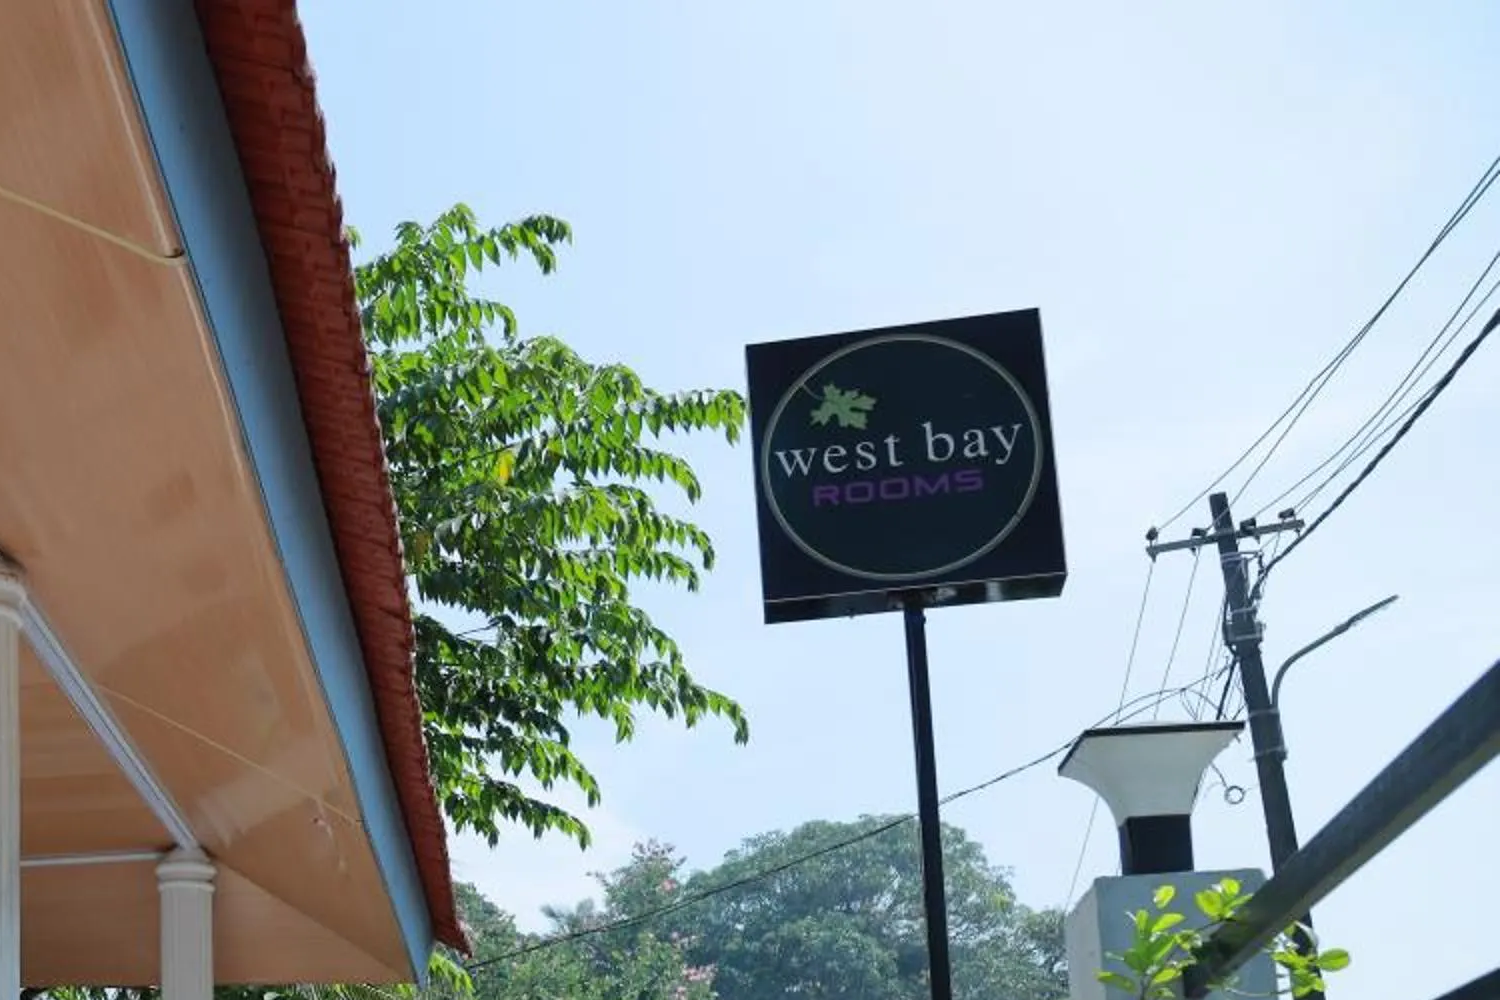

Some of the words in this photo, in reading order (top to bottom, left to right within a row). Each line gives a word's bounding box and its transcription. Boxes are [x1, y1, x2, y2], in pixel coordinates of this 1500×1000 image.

[775, 434, 904, 478] west
[921, 421, 1023, 465] bay
[812, 469, 985, 507] ROOMS
